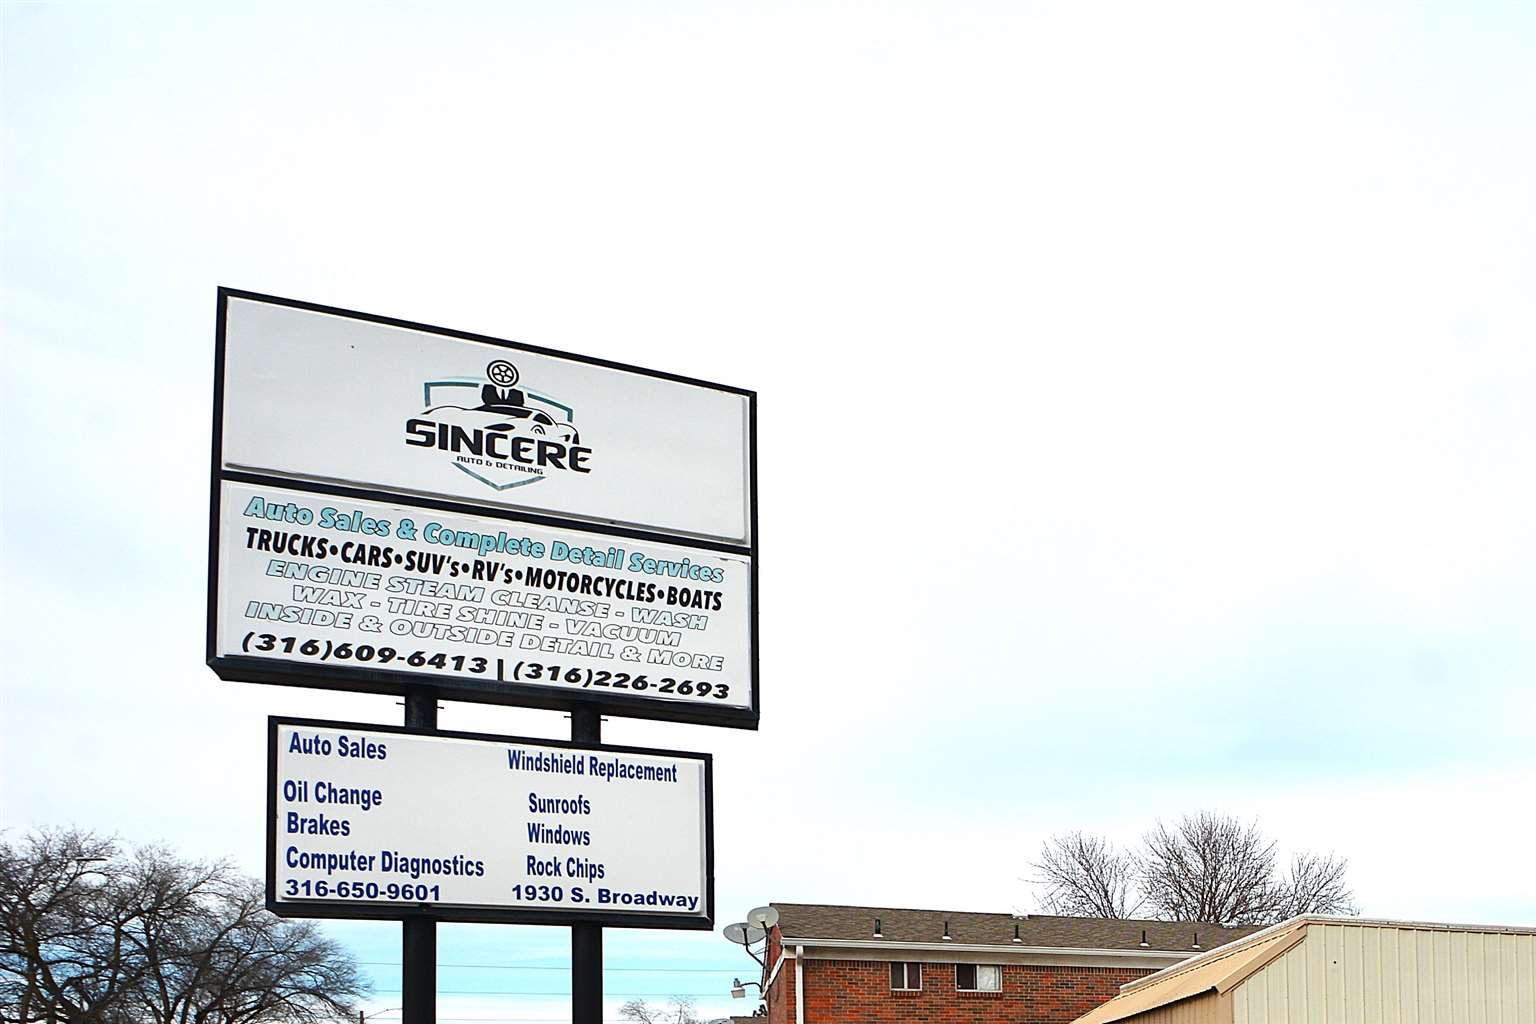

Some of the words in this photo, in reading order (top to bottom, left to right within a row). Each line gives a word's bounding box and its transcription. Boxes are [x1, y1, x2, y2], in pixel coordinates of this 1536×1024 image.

[406, 418, 592, 474] SINCERE
[456, 455, 483, 465] AUTO
[496, 461, 543, 475] DETAILING
[243, 496, 314, 525] Auto
[317, 507, 391, 537] Sales
[396, 519, 418, 541] &
[423, 522, 545, 558] Complete
[550, 541, 625, 570] Detail
[628, 552, 724, 583] Services
[266, 559, 382, 590] ENGINE
[385, 576, 486, 603] STEAM
[491, 589, 610, 618] CLEANSE
[631, 607, 708, 631] WASH
[292, 585, 366, 609] WAX
[388, 597, 453, 620] TIRE
[456, 606, 544, 631] SHINE
[565, 619, 682, 647] VACUUM
[244, 601, 353, 630] INSIDE
[359, 615, 383, 633] &
[389, 619, 514, 647] OUTSIDE
[519, 634, 615, 660] DETAIL
[620, 646, 642, 663] &
[647, 648, 725, 671] MORE
[242, 631, 488, 674] (316)609-6413
[513, 661, 730, 700] (316)226-2693
[289, 731, 332, 755] Auto
[338, 735, 387, 760] Sales
[507, 749, 584, 775] Windshield
[589, 756, 677, 782] Replacement
[283, 780, 308, 803] Oil
[314, 781, 383, 811] Change
[528, 792, 591, 815] Sunroofs
[287, 811, 350, 836] Brakes
[527, 822, 591, 846] Windows
[286, 846, 376, 875] Computer
[381, 850, 485, 879] Diagnostics
[527, 855, 562, 877] Rock
[566, 857, 605, 883] Chips
[285, 879, 440, 901] 316-650-9601
[512, 884, 563, 902] 1930
[570, 886, 590, 903] S.
[597, 887, 699, 911] Broadway
